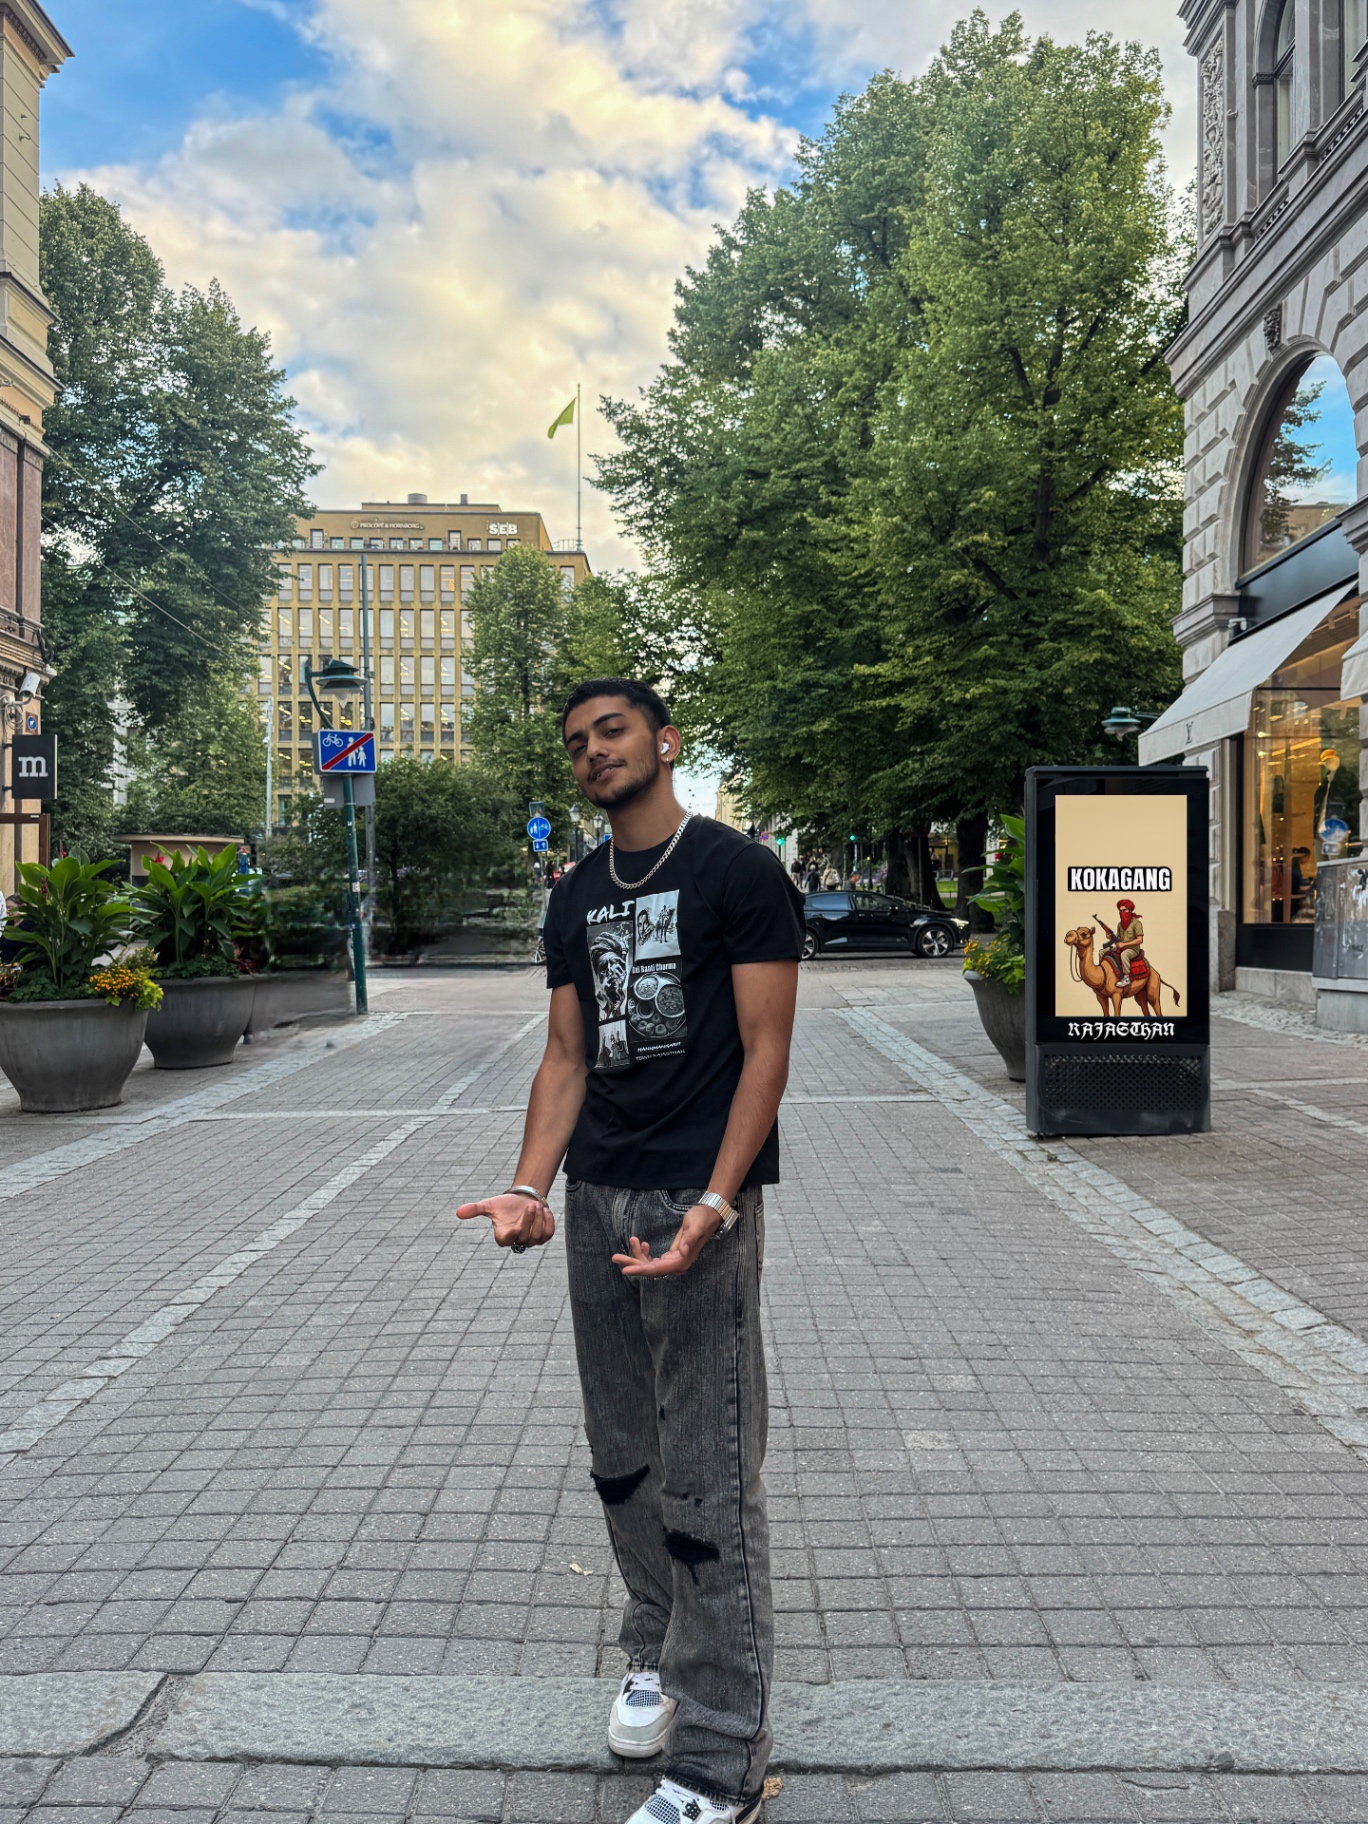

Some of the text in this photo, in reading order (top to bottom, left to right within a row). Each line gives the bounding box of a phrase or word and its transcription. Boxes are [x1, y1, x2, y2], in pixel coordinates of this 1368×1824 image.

[488, 522, 518, 536] SEB
[18, 756, 48, 777] m
[1070, 867, 1172, 891] KOKAGANG
[586, 900, 635, 925] KALI
